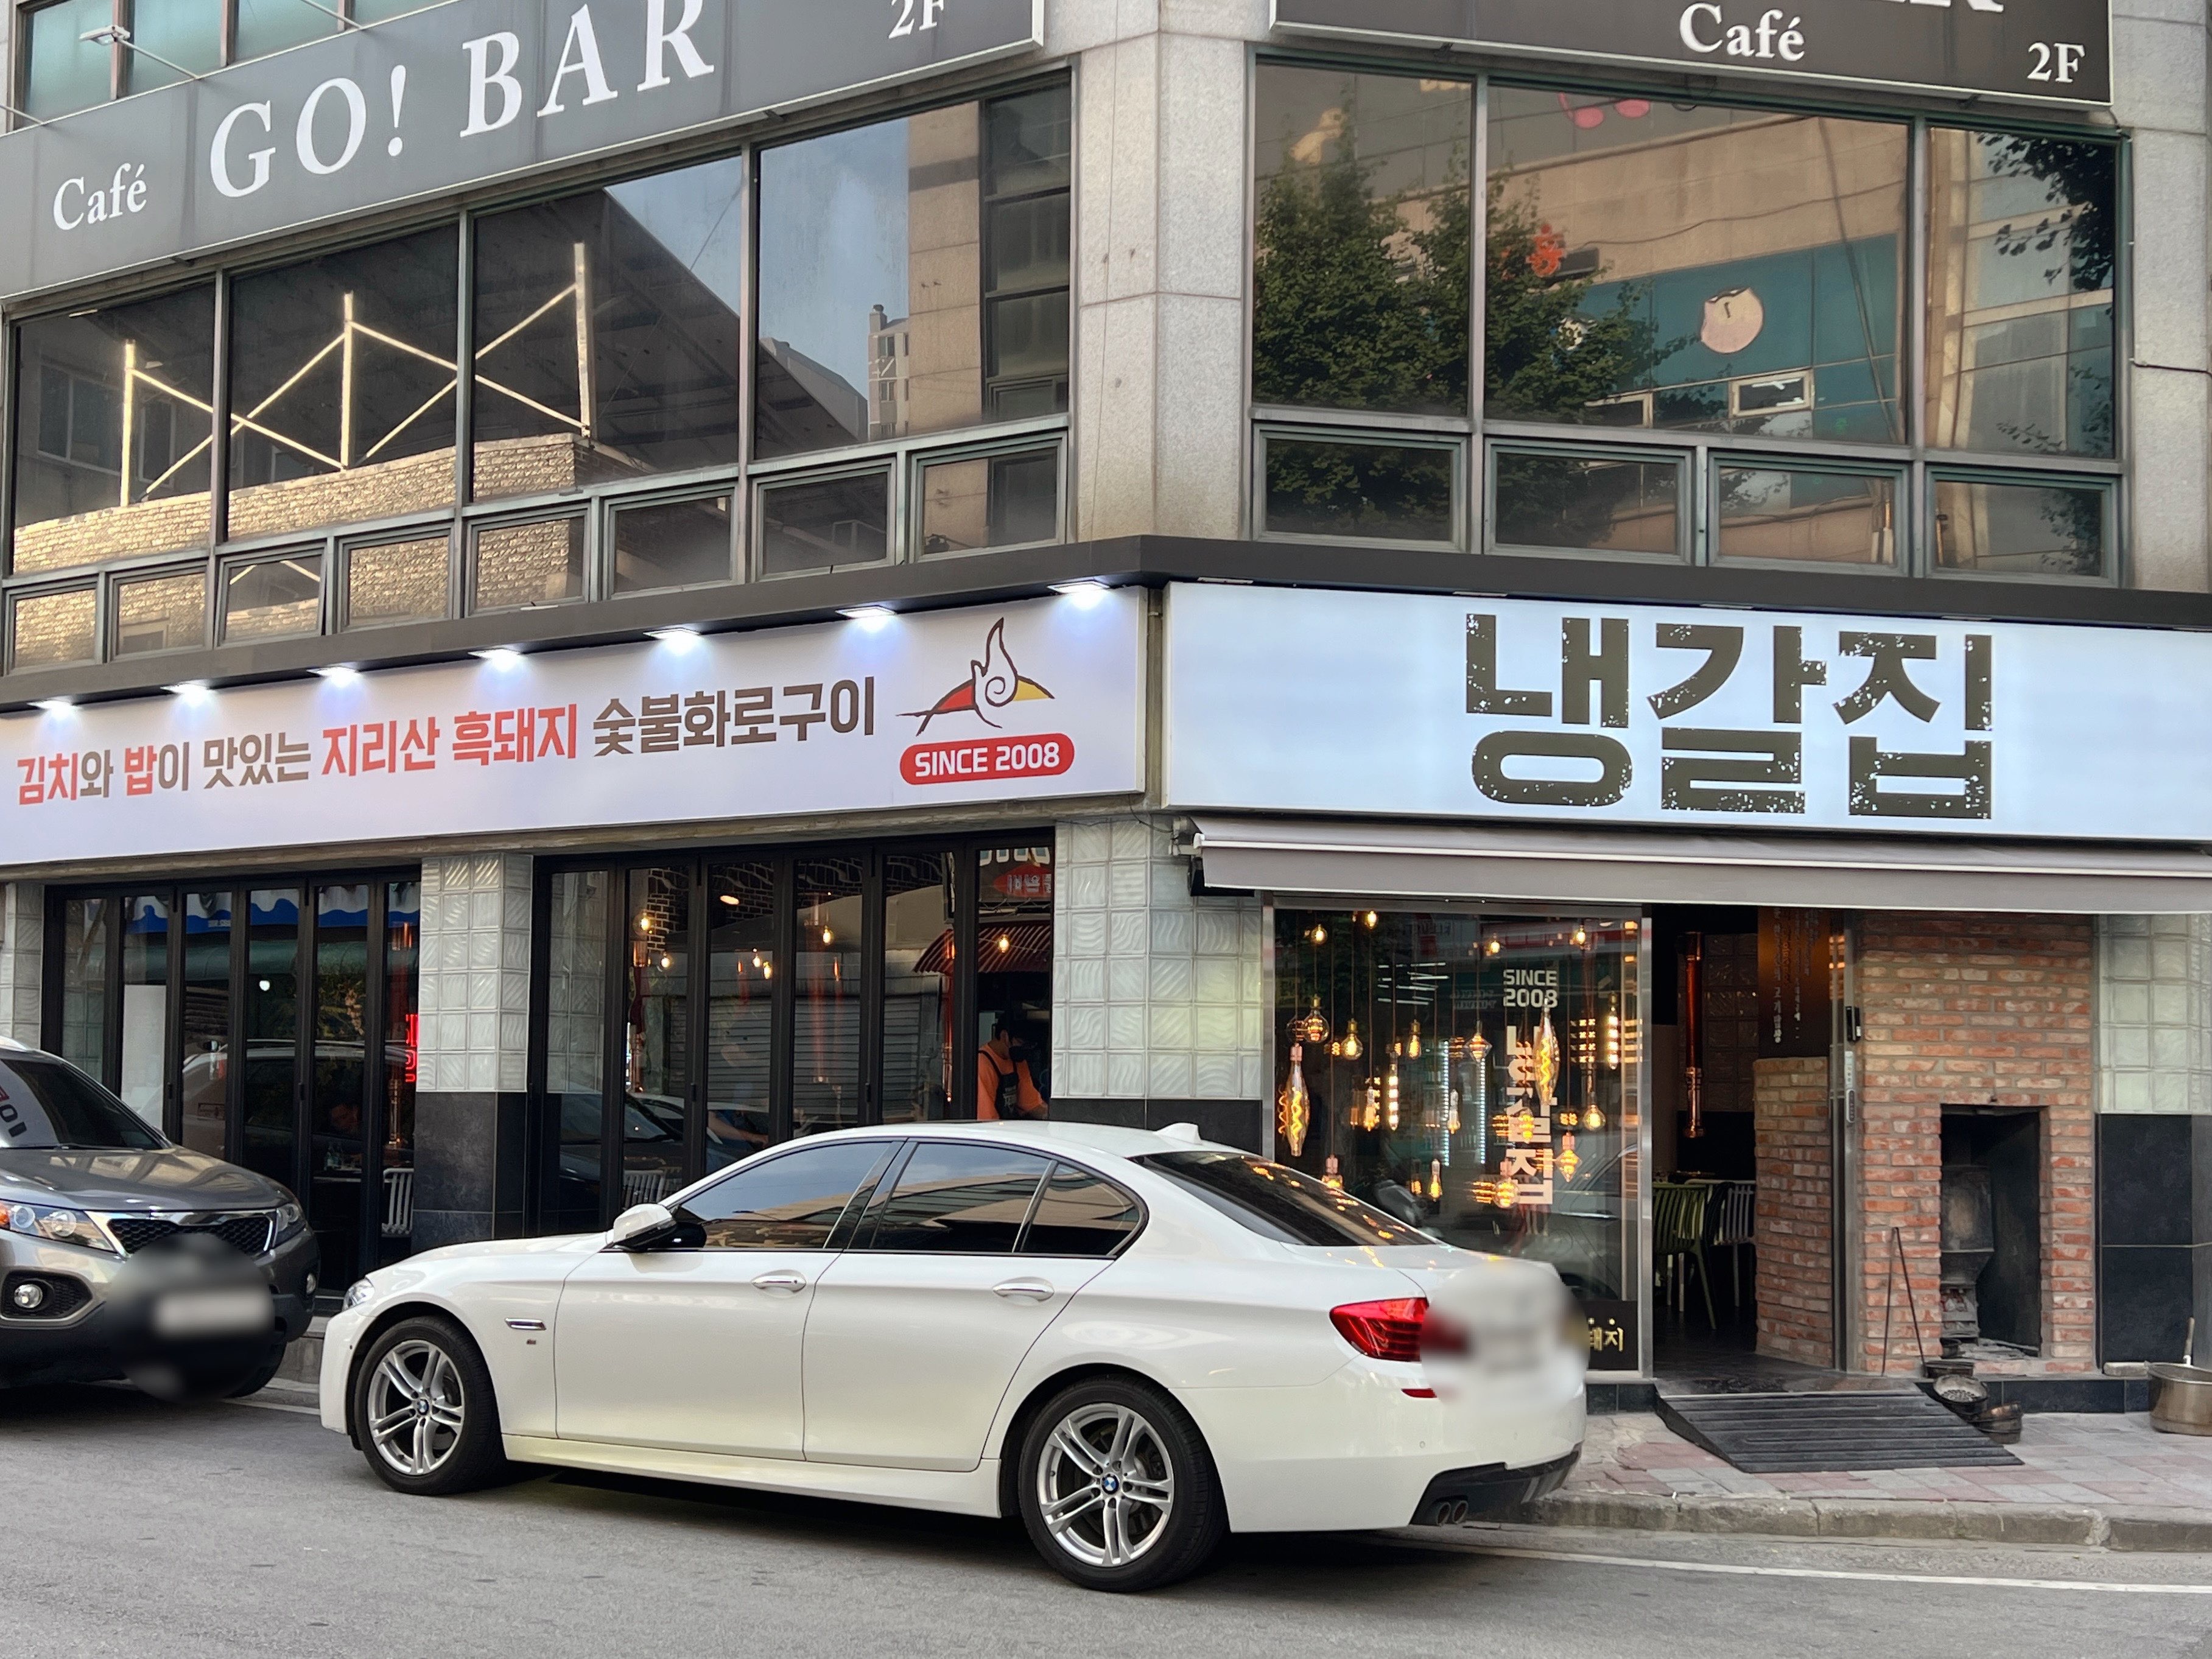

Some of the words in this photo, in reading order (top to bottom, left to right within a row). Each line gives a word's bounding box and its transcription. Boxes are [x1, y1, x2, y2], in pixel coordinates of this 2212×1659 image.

[888, 0, 944, 39] 2F
[1679, 2, 1805, 61] Café
[2027, 41, 2085, 83] 2F
[54, 163, 147, 231] Café
[210, 65, 407, 198] GO!
[459, 0, 715, 138] BAR
[1465, 612, 1993, 821] 냉갈집
[16, 749, 114, 805] 김치와
[124, 741, 189, 796] 밥이
[203, 732, 312, 790] 맛있는
[321, 716, 440, 777] 지리산
[452, 703, 578, 766] 흑돼지
[592, 676, 875, 758] 숯불화로구이
[914, 746, 989, 779] SINCE
[995, 742, 1060, 773] 2008
[1503, 969, 1557, 986] SINCE
[1503, 988, 1558, 1008] 2008
